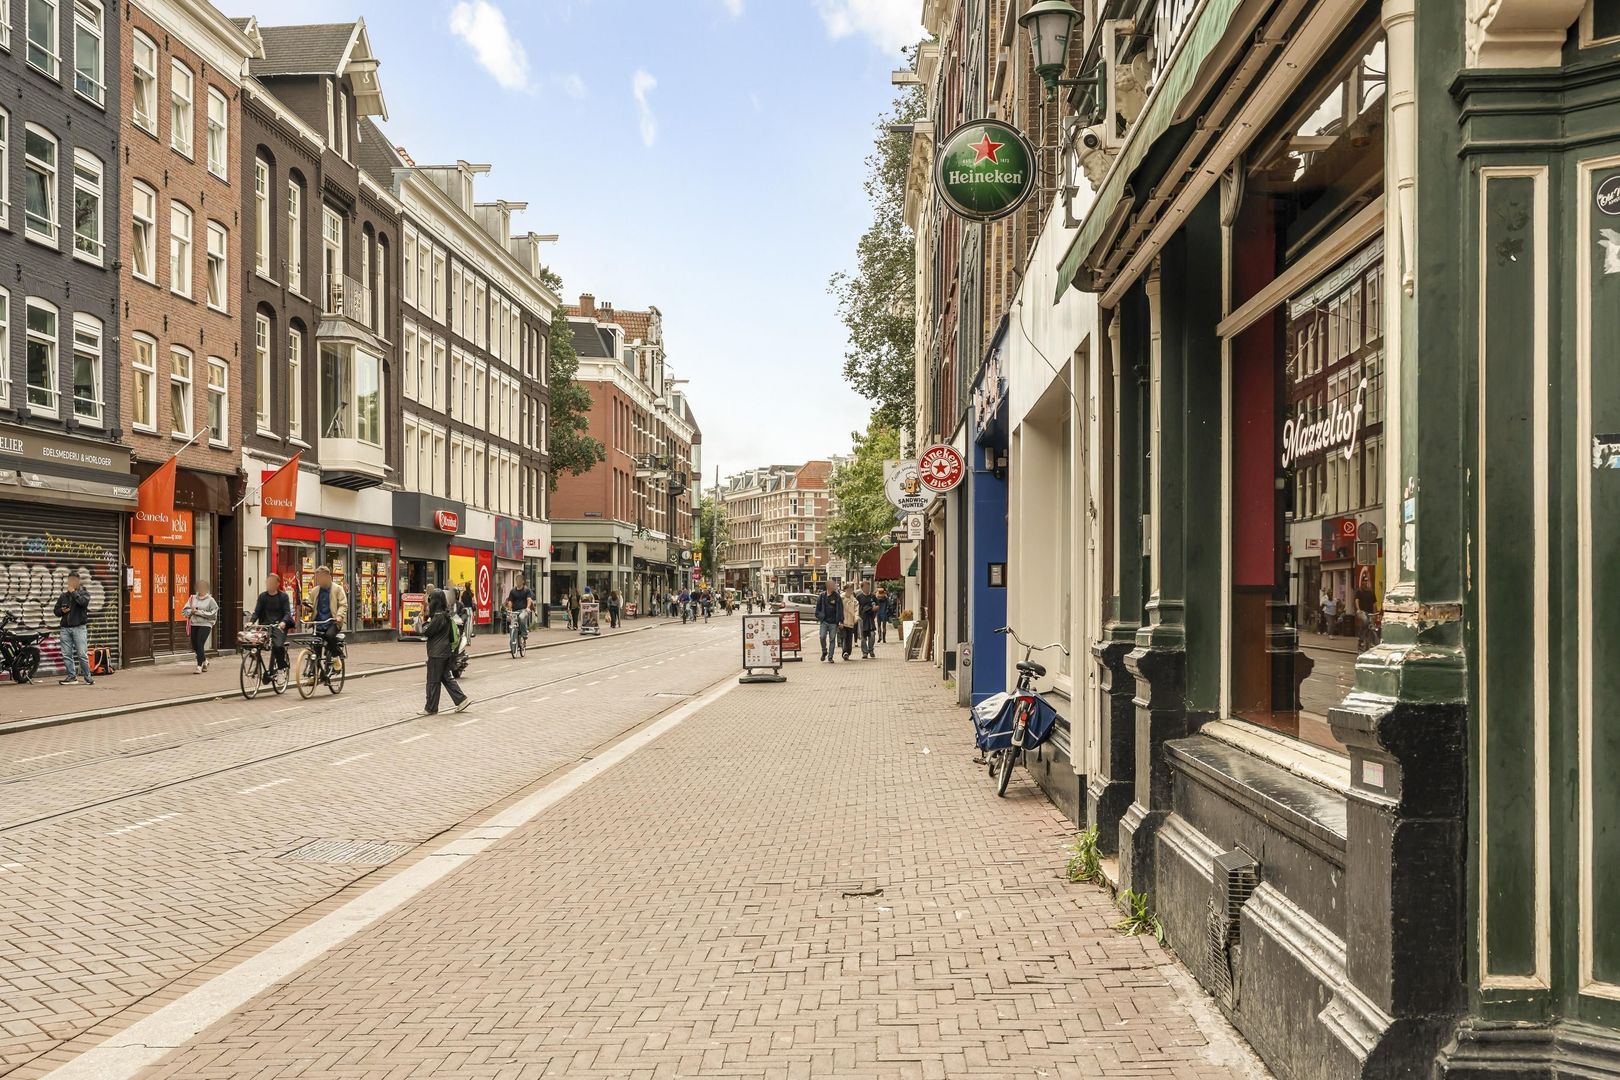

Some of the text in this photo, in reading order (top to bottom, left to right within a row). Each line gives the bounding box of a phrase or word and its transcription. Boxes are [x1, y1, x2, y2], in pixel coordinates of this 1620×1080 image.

[948, 170, 1022, 184] Heineken
[1282, 377, 1368, 468] Mazzeltof
[42, 447, 112, 466] EDELSMEDERIJ & HORLOGER
[920, 448, 961, 477] Heineken's
[930, 478, 952, 488] Bier
[264, 496, 293, 507] Canela
[136, 510, 169, 523] Canela
